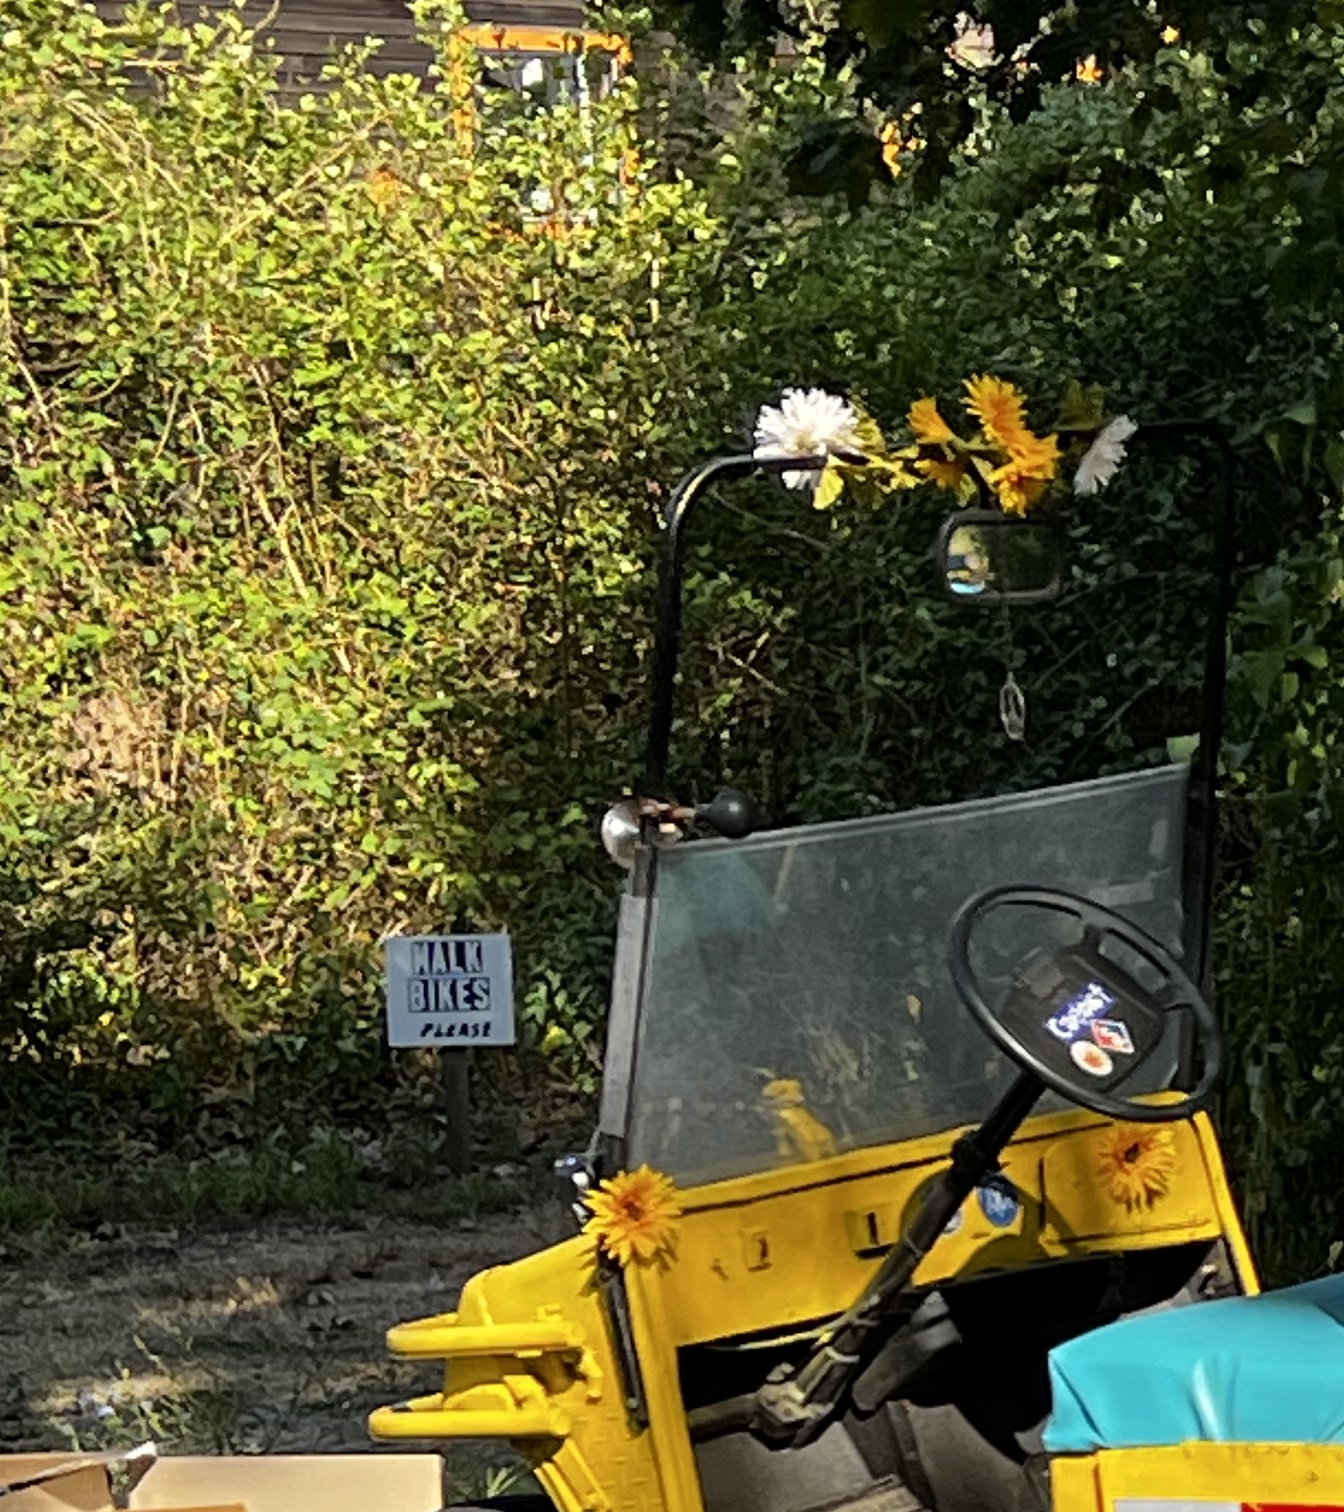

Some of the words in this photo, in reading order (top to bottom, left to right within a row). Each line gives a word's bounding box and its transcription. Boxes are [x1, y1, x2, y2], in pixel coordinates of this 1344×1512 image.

[411, 940, 483, 975] WALK
[408, 977, 491, 1013] BIKES
[419, 1021, 492, 1038] PLEASE
